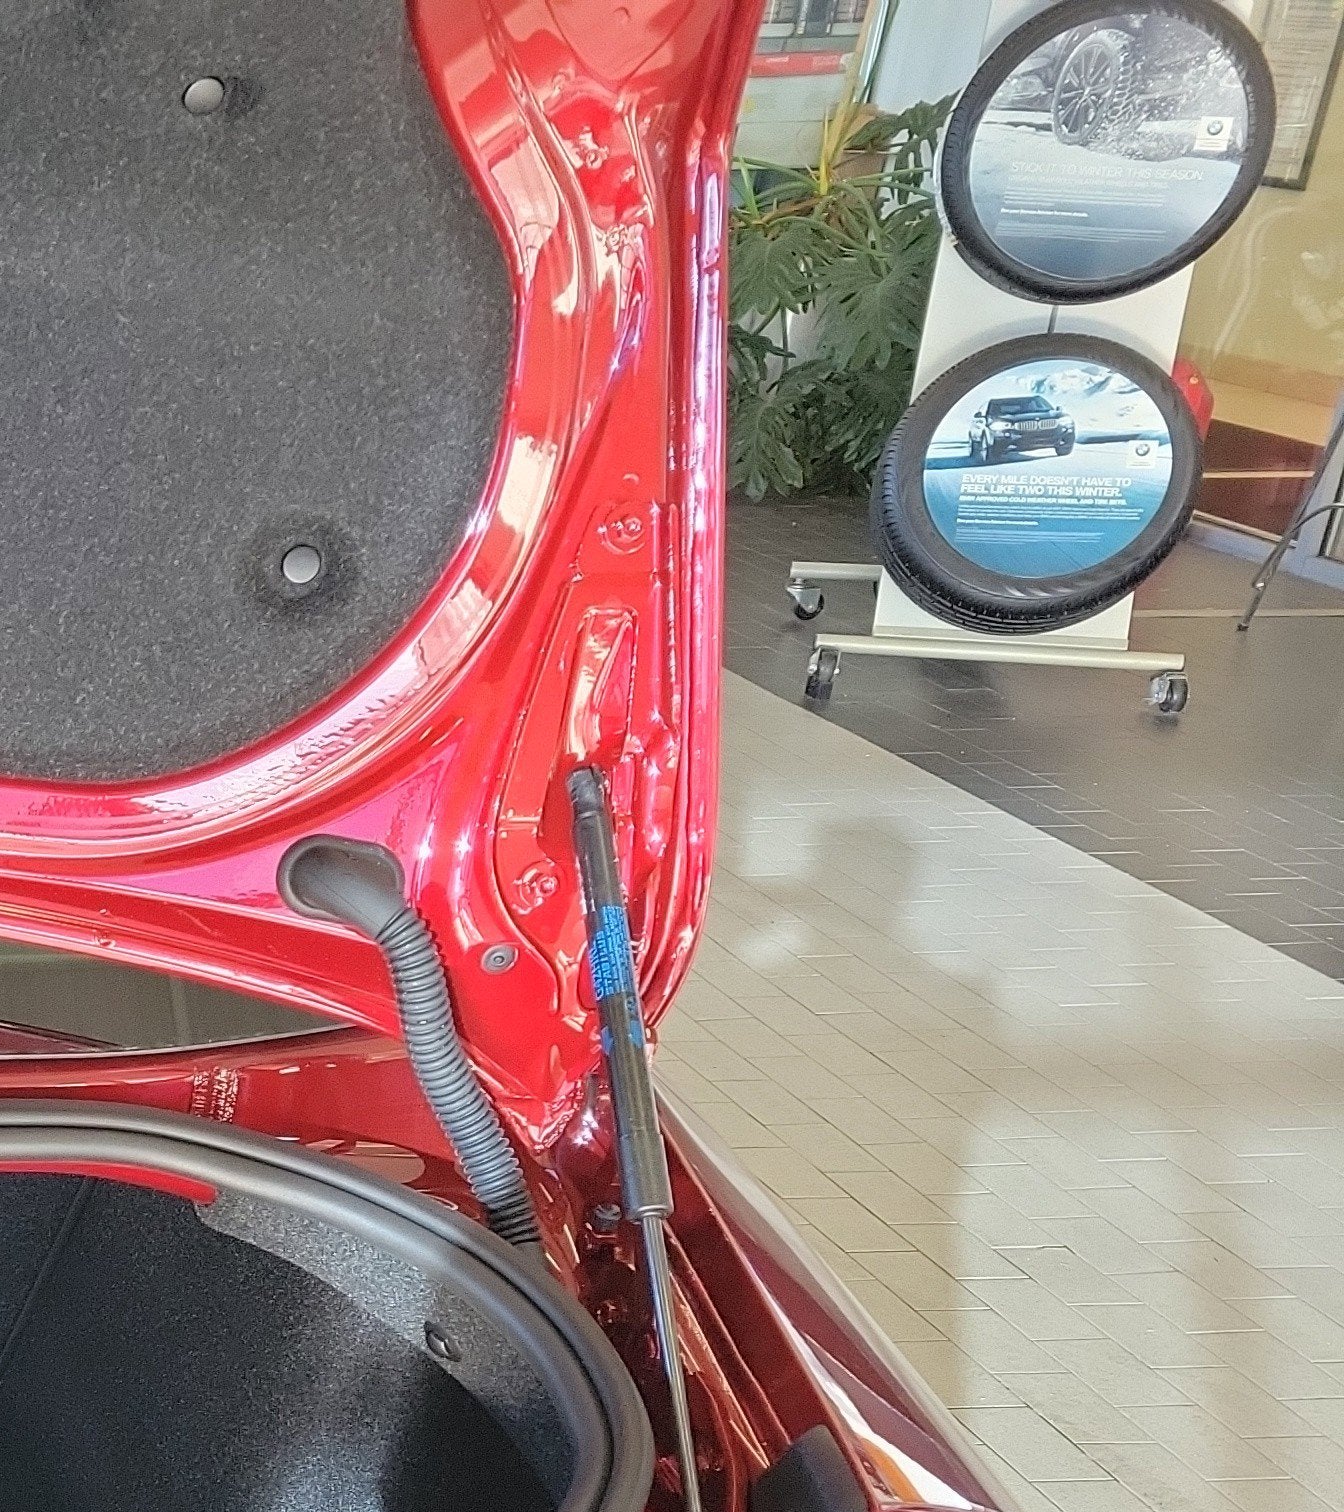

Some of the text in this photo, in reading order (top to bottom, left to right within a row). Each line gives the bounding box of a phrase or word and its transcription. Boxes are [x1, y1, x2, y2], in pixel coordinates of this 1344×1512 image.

[962, 475, 1131, 486] EVERY MILE DOESN'T HAVE TO
[961, 484, 1122, 496] FEEL LIKE TWO THIS WINTER.
